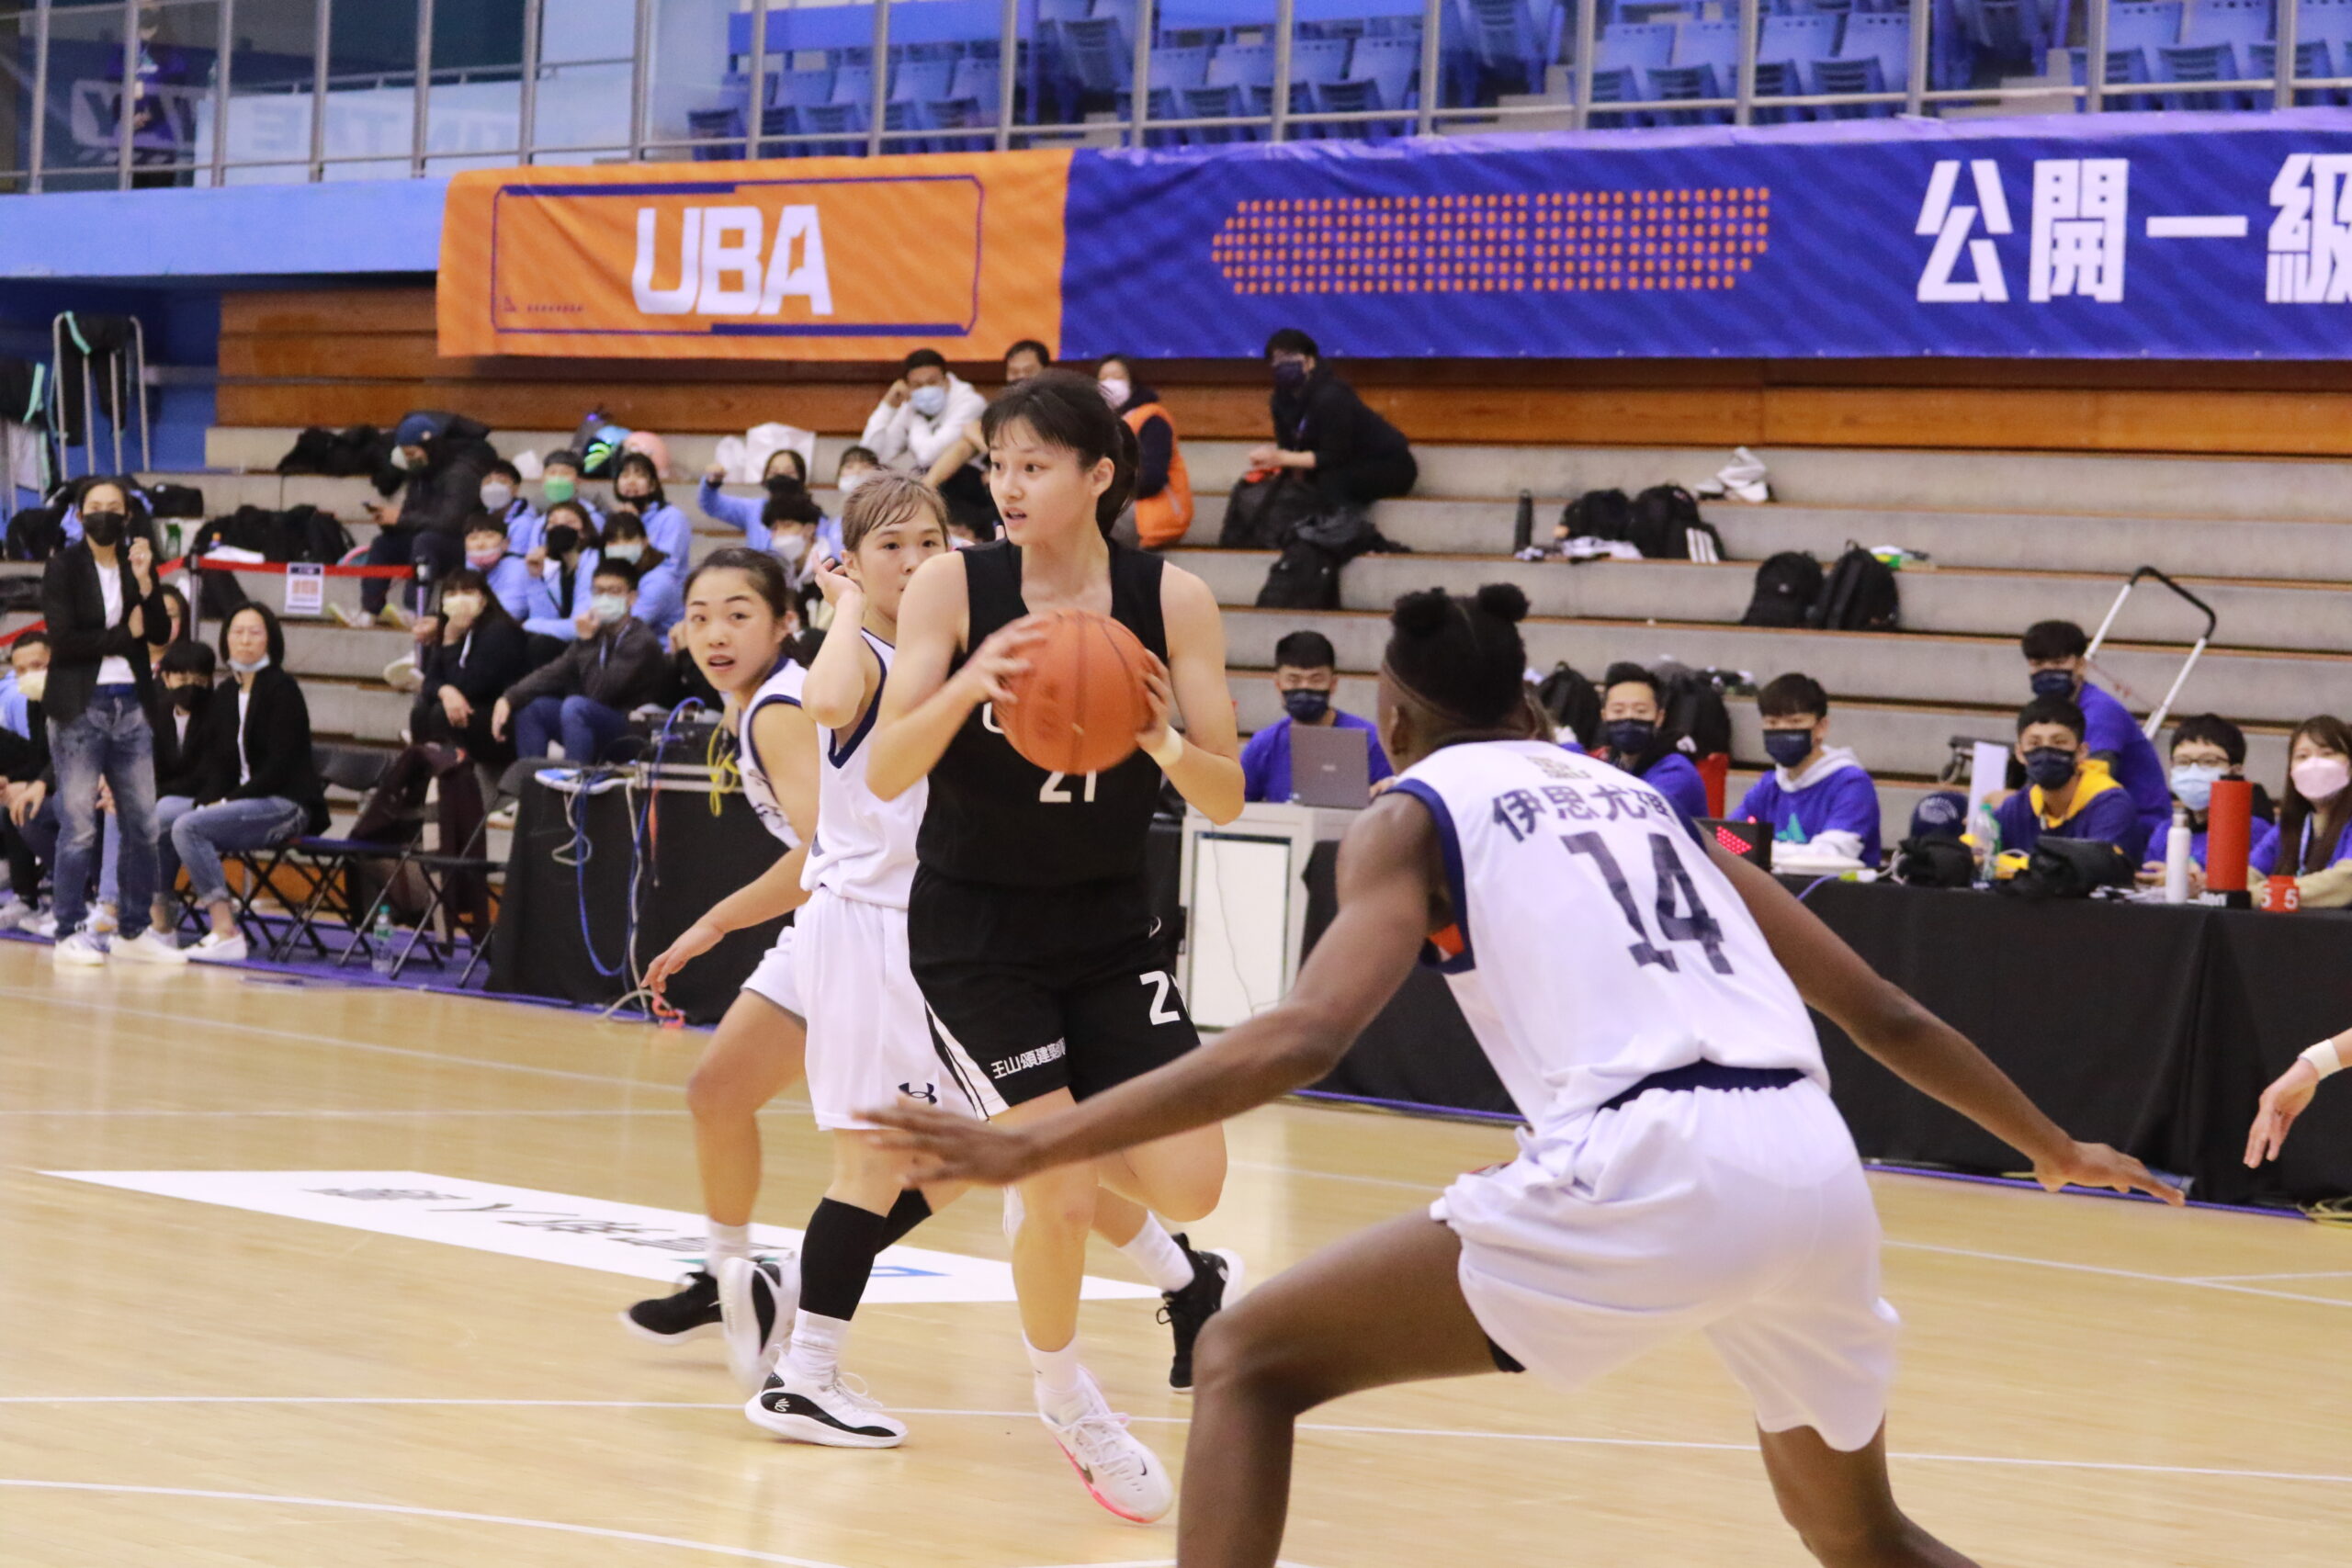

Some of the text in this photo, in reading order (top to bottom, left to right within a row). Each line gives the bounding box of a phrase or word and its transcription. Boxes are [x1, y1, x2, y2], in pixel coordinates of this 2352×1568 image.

[631, 204, 833, 315] UBA
[1915, 152, 2352, 304] 公開一級
[1559, 830, 1735, 975] 14
[1139, 970, 1192, 1026] 2
